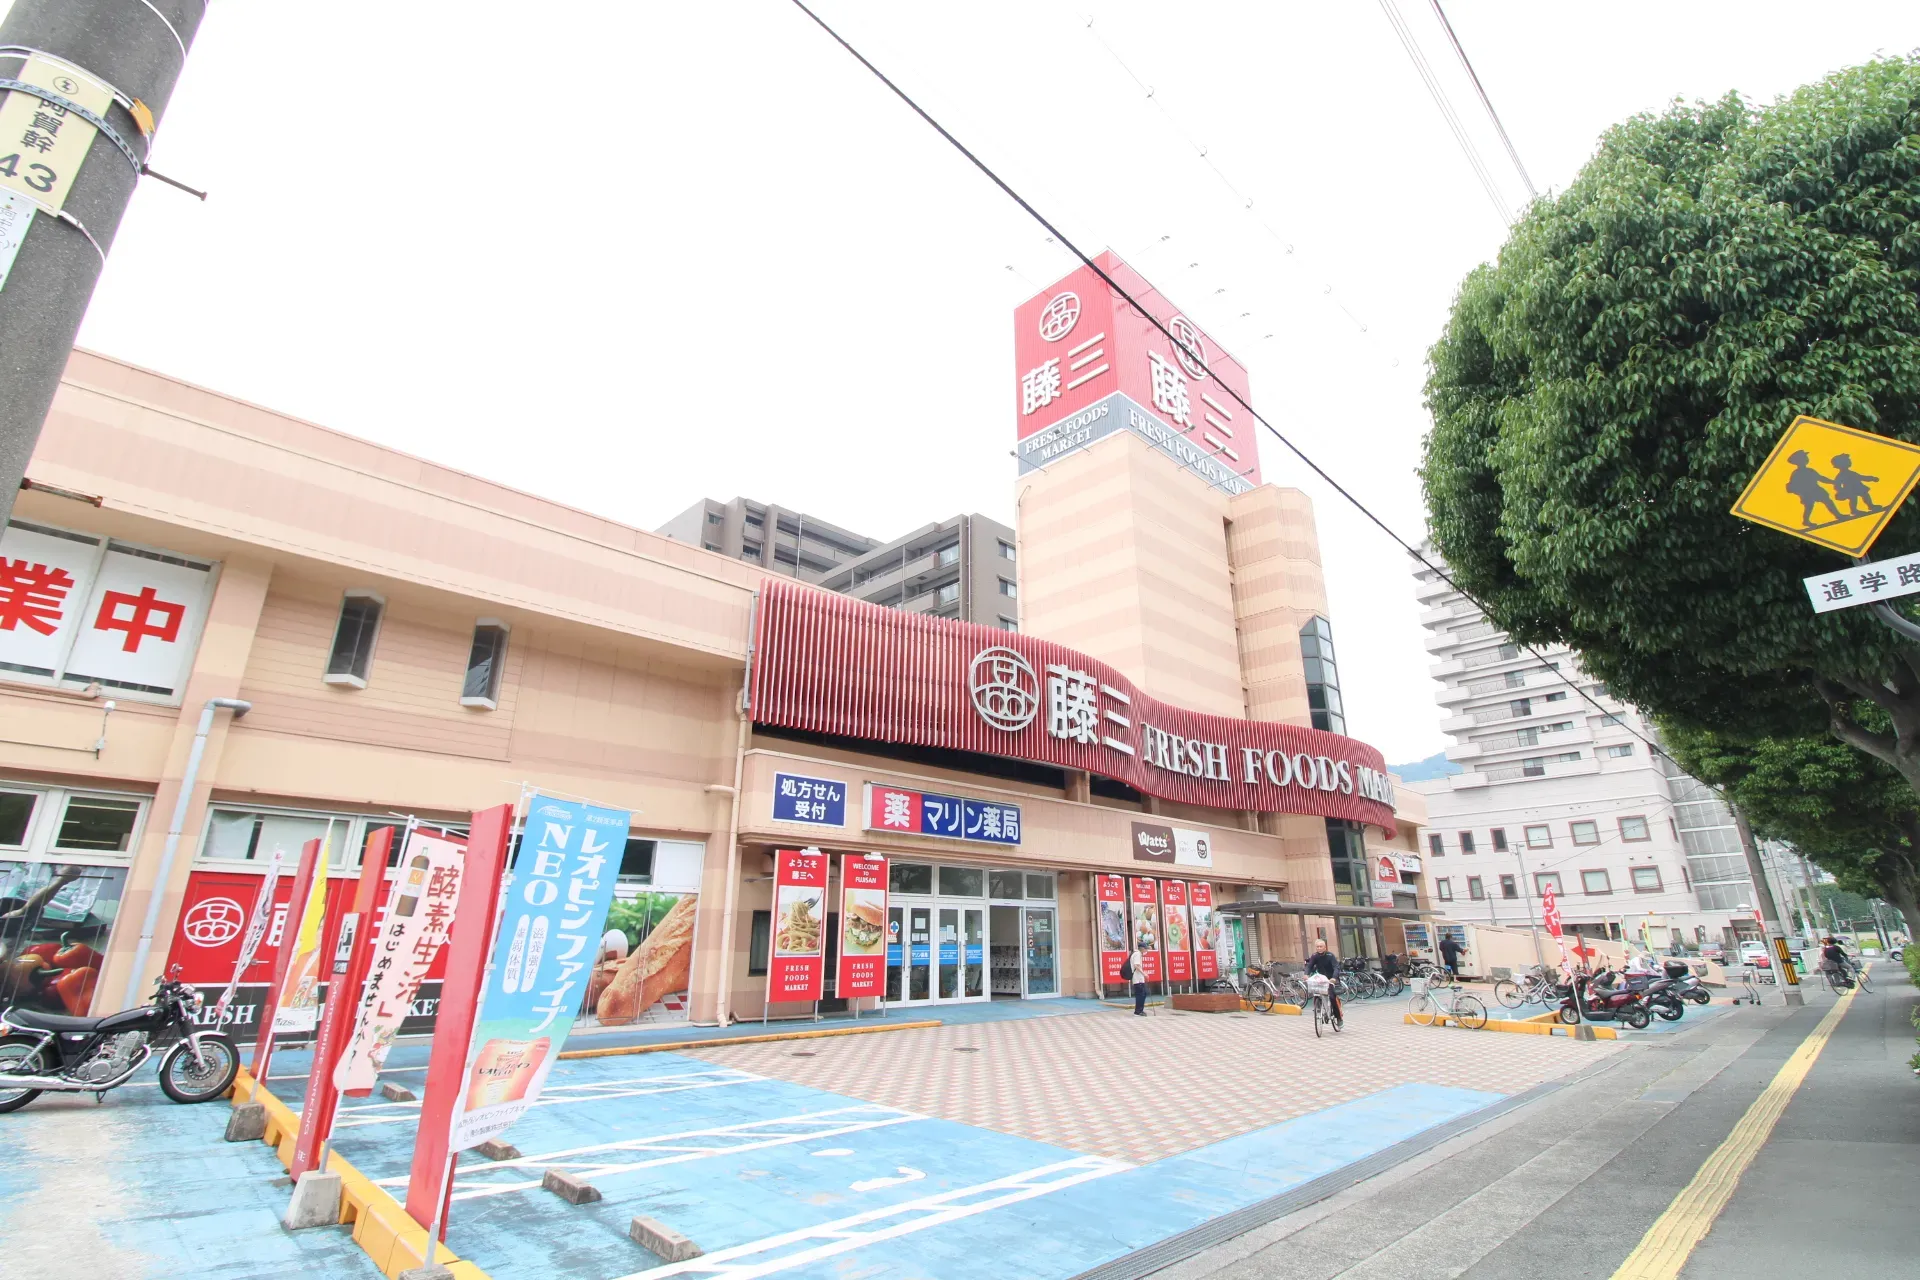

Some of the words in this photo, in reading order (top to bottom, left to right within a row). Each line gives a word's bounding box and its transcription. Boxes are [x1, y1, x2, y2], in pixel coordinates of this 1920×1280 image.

[0, 153, 57, 193] 43
[1021, 332, 1110, 416] 藤三
[1147, 349, 1239, 463] 藤三
[1024, 427, 1065, 456] FRESH
[1065, 402, 1110, 434] FOODS
[1041, 428, 1092, 462] MARKET
[1128, 407, 1174, 451] FRESH
[1175, 441, 1217, 481] FOODS
[1821, 563, 1920, 602] 通学路
[1046, 664, 1135, 756] 藤三
[1140, 722, 1231, 782] FRESH
[1240, 747, 1354, 795] FOODS
[781, 778, 840, 802] 処方せん
[795, 801, 826, 820] 受付
[884, 792, 910, 828] 薬
[924, 801, 1019, 840] マリン薬局
[1138, 831, 1168, 848] Watts
[523, 821, 576, 906] NEO
[789, 859, 818, 869] ようこそ
[792, 870, 814, 880] 藤三へ
[853, 863, 879, 871] WELCOME
[855, 876, 877, 884] FUJISAN
[528, 828, 610, 1033] レオピンファイブ
[186, 1004, 257, 1025] RESH
